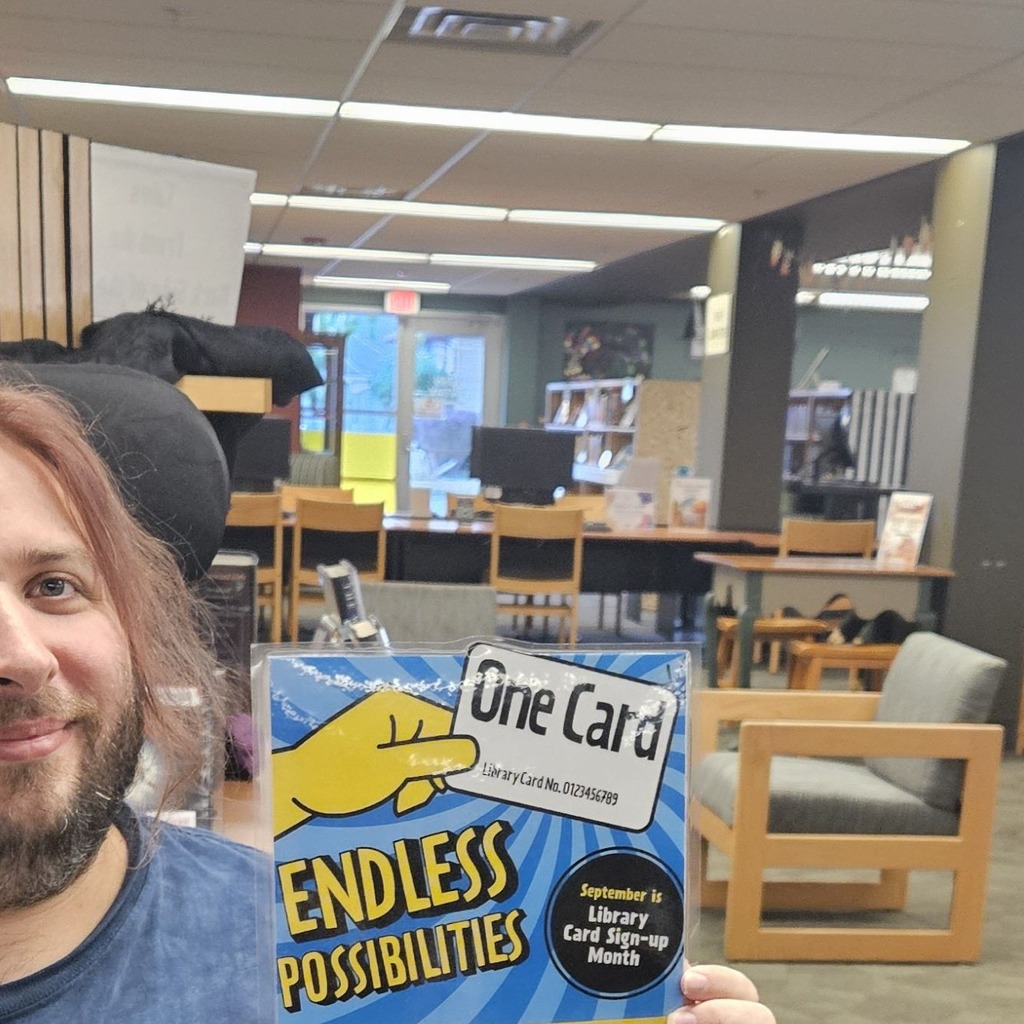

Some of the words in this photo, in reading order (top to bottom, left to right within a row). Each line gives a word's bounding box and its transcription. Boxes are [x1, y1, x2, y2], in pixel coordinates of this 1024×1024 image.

[471, 659, 556, 736] One
[562, 683, 667, 761] Card
[482, 762, 522, 785] Library
[520, 772, 543, 789] Card
[545, 778, 561, 793] No.
[563, 782, 619, 806] 0123456789
[276, 820, 520, 943] ENDLESS
[580, 883, 647, 902] September
[651, 888, 663, 904] is
[588, 905, 649, 930] Library
[563, 924, 601, 943] Card
[606, 927, 669, 951] Sign-up
[276, 908, 531, 1014] POSSIBILITIES
[587, 946, 641, 966] Month
